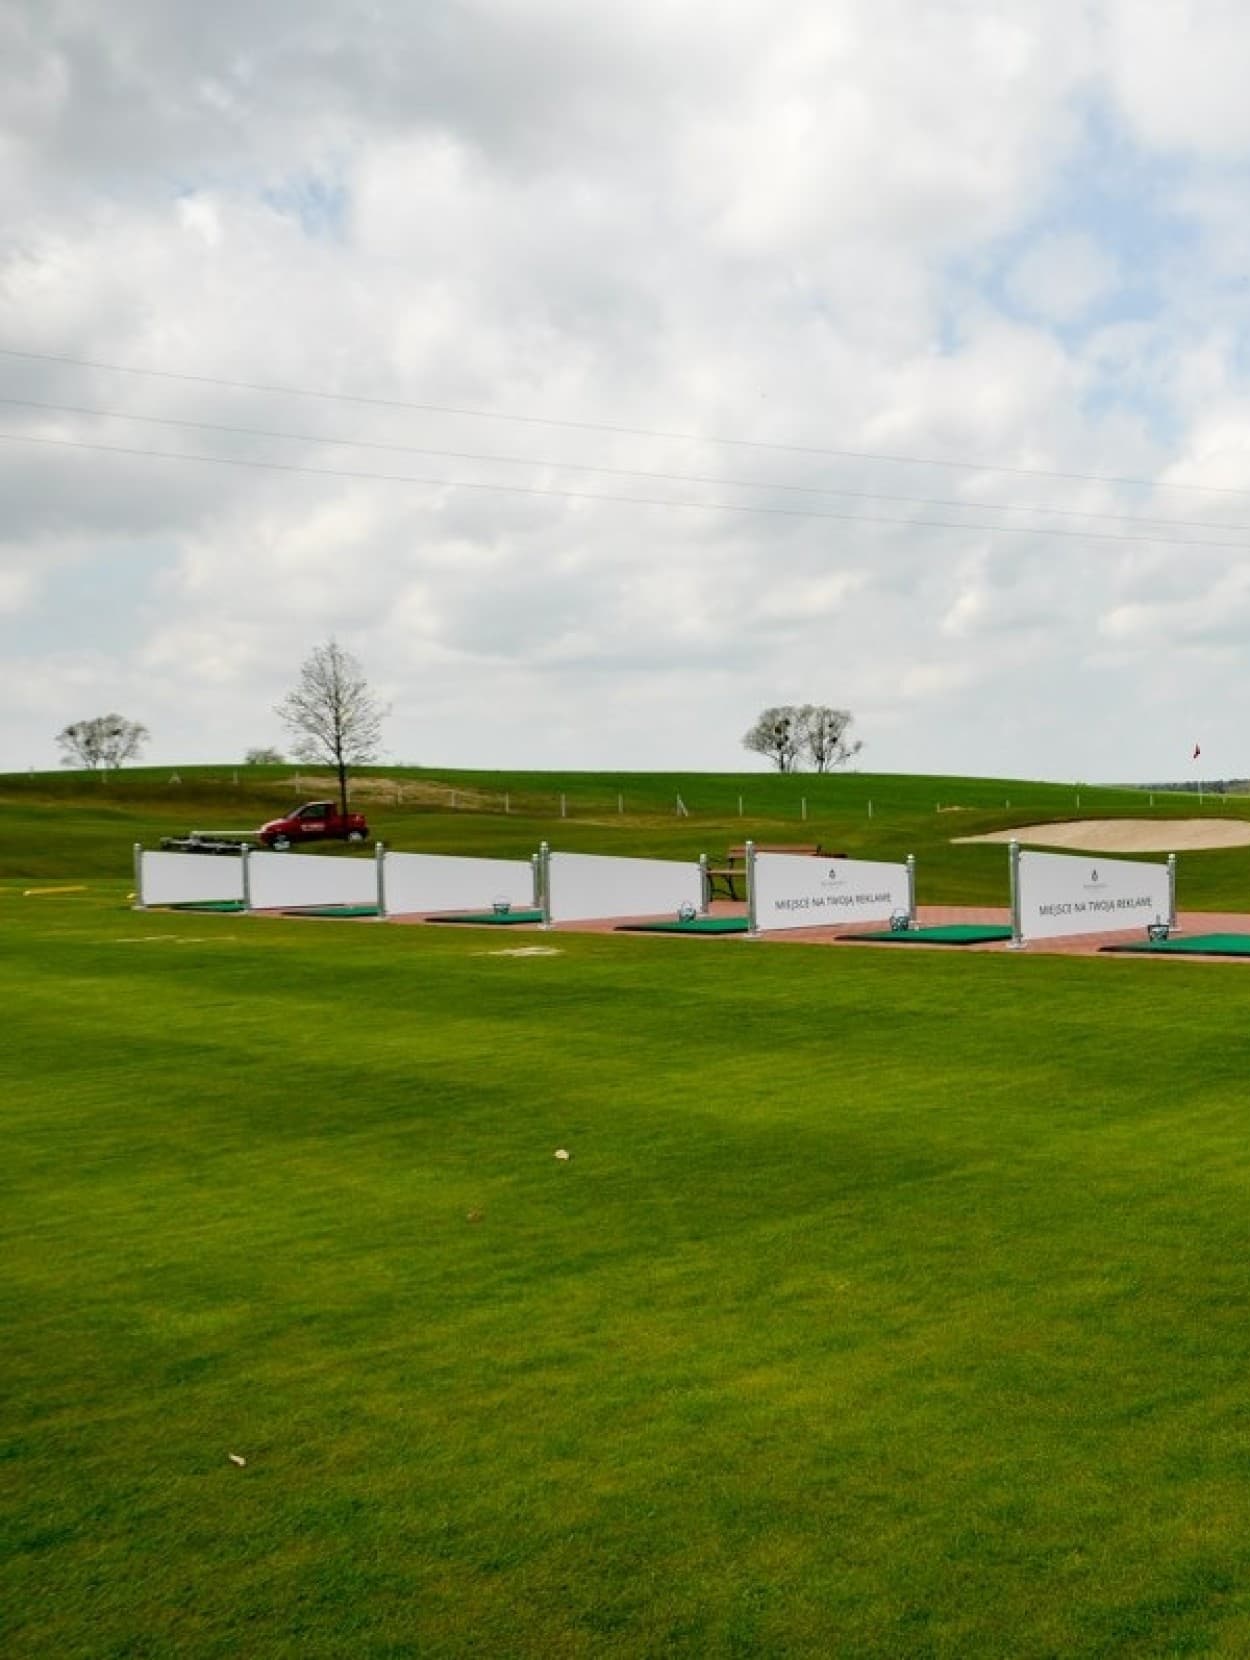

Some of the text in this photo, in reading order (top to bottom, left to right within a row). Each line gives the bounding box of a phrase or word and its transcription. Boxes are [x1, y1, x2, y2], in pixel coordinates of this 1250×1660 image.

[812, 897, 825, 906] NA
[1039, 903, 1072, 917] MIEJSCE
[1074, 902, 1086, 912] NA
